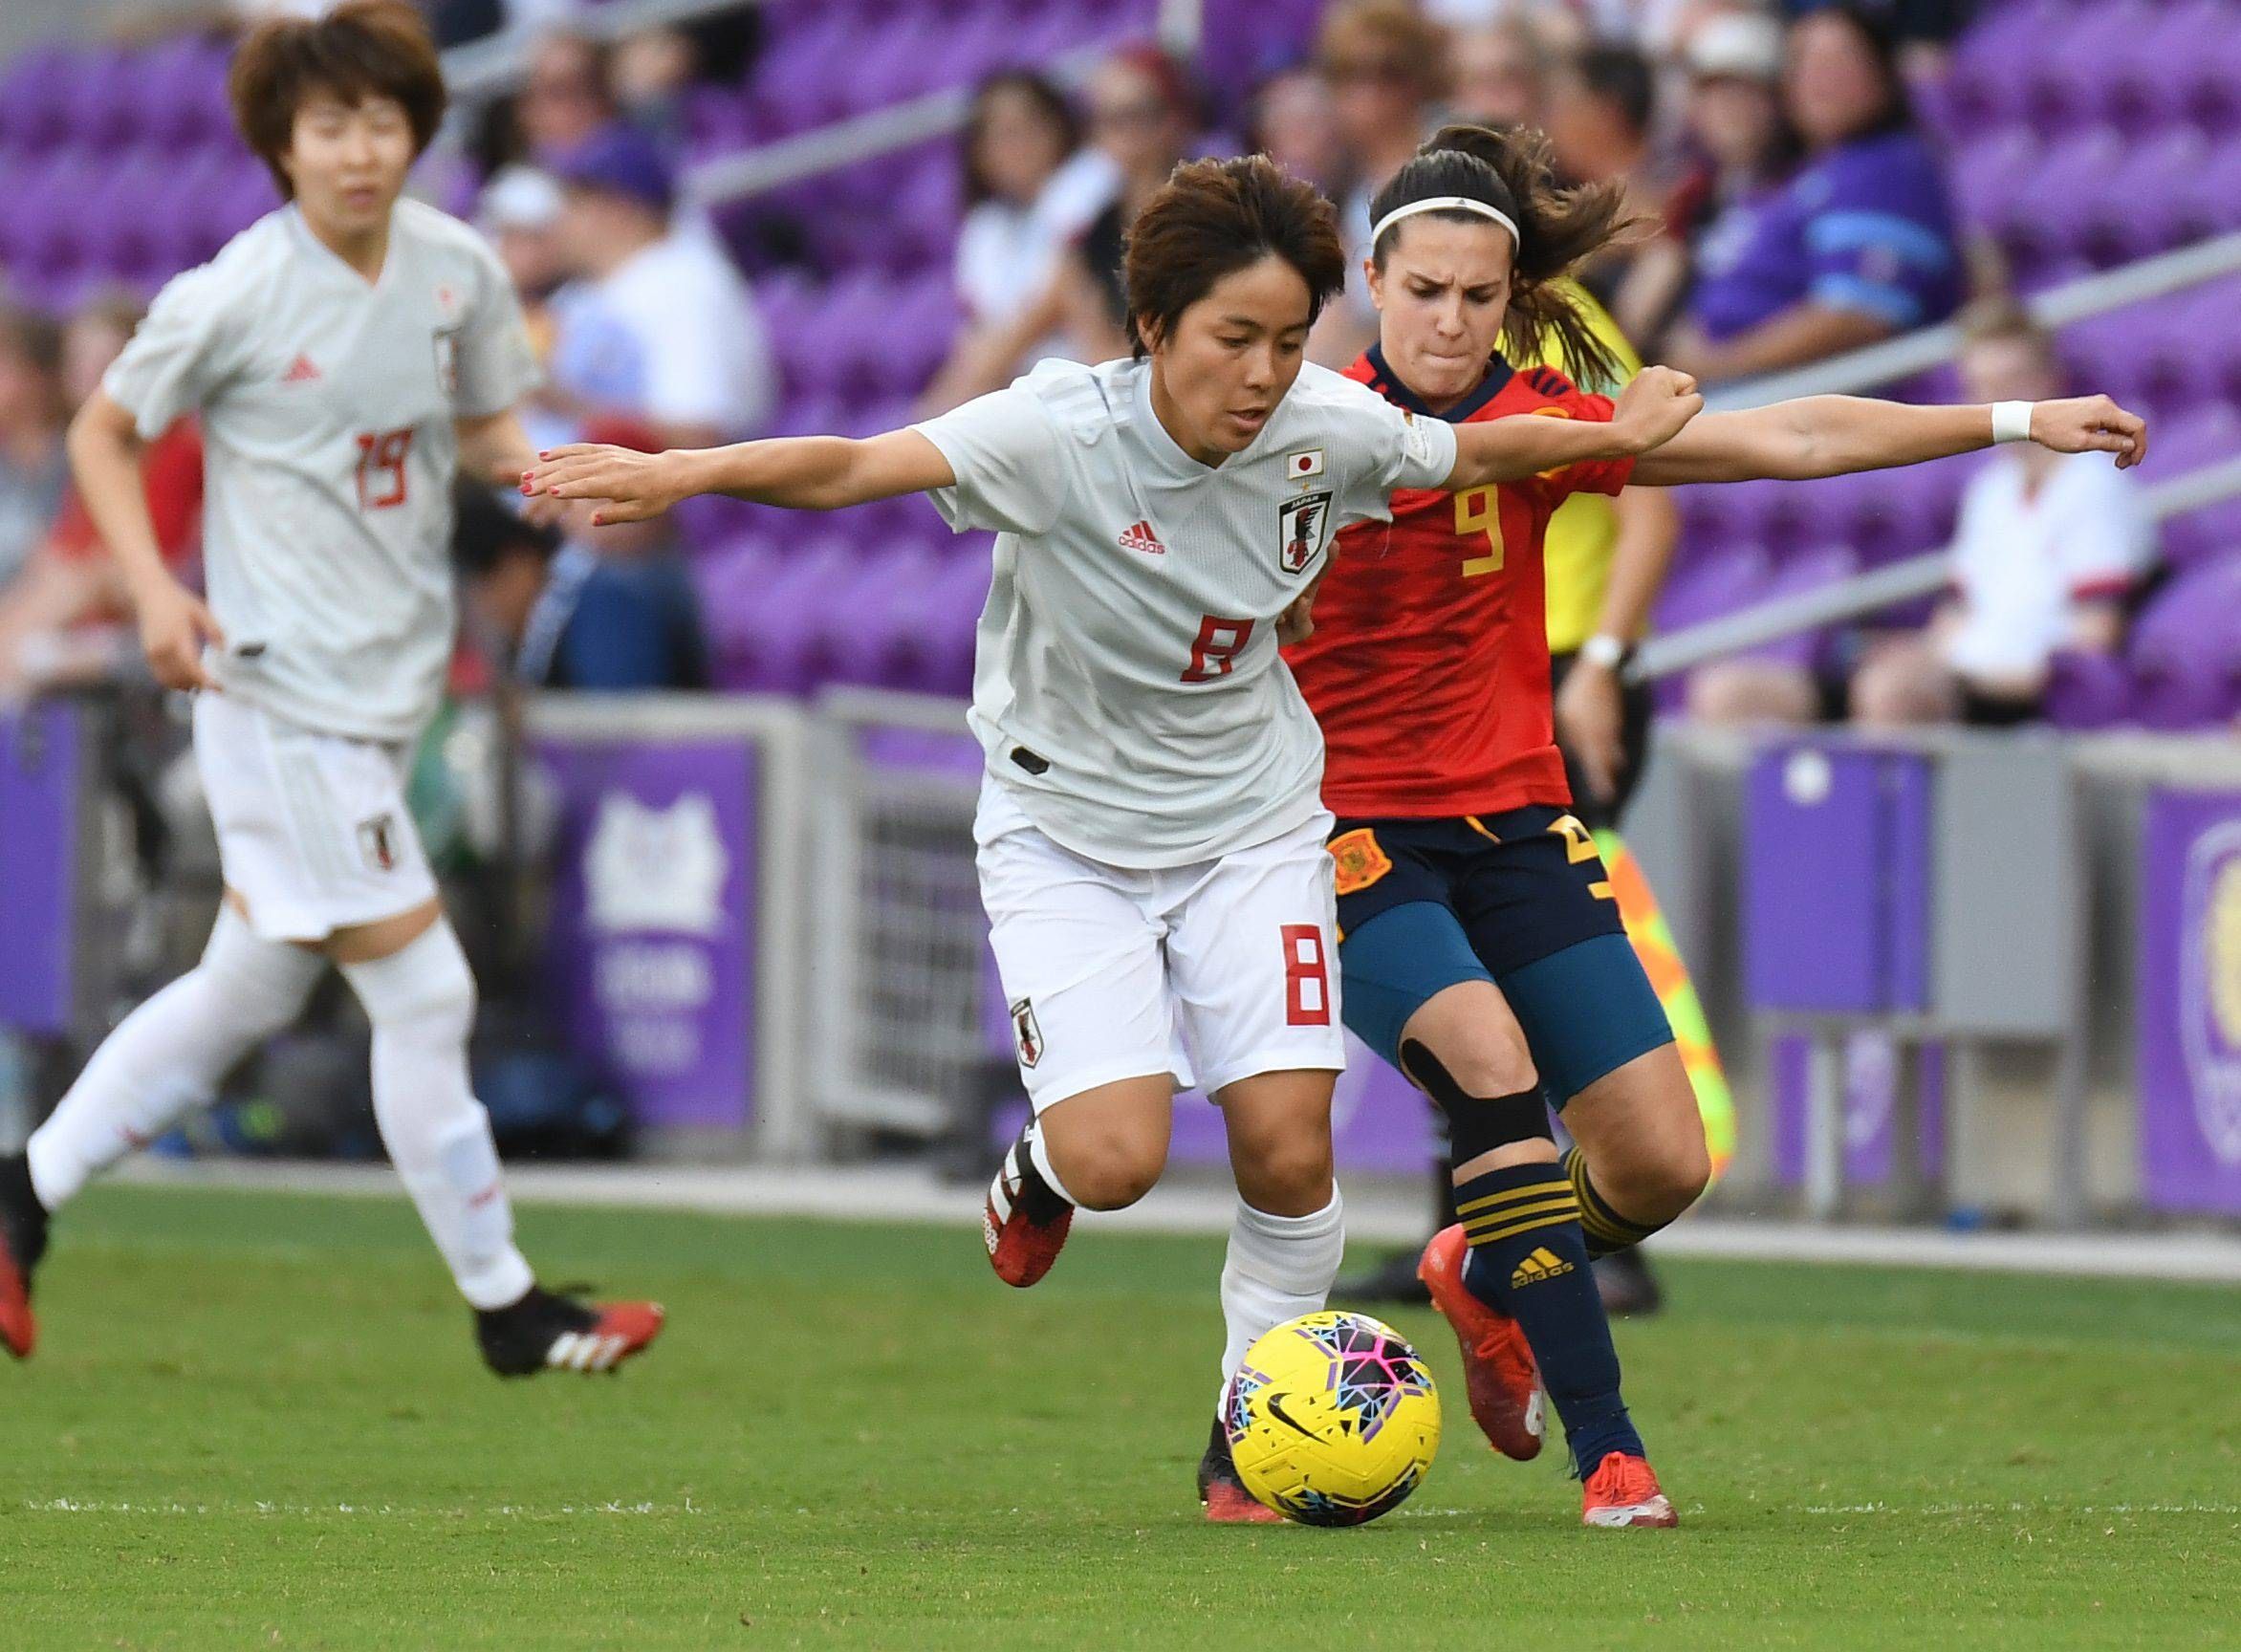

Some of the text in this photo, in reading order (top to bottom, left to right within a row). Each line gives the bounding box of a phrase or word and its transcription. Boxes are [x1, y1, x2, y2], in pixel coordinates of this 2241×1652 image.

[355, 426, 413, 510] 19
[1118, 535, 1165, 554] adidas
[1454, 484, 1504, 577] 9
[1180, 615, 1255, 683] 8
[1279, 924, 1330, 1027] 8
[1511, 1261, 1575, 1290] adidas
